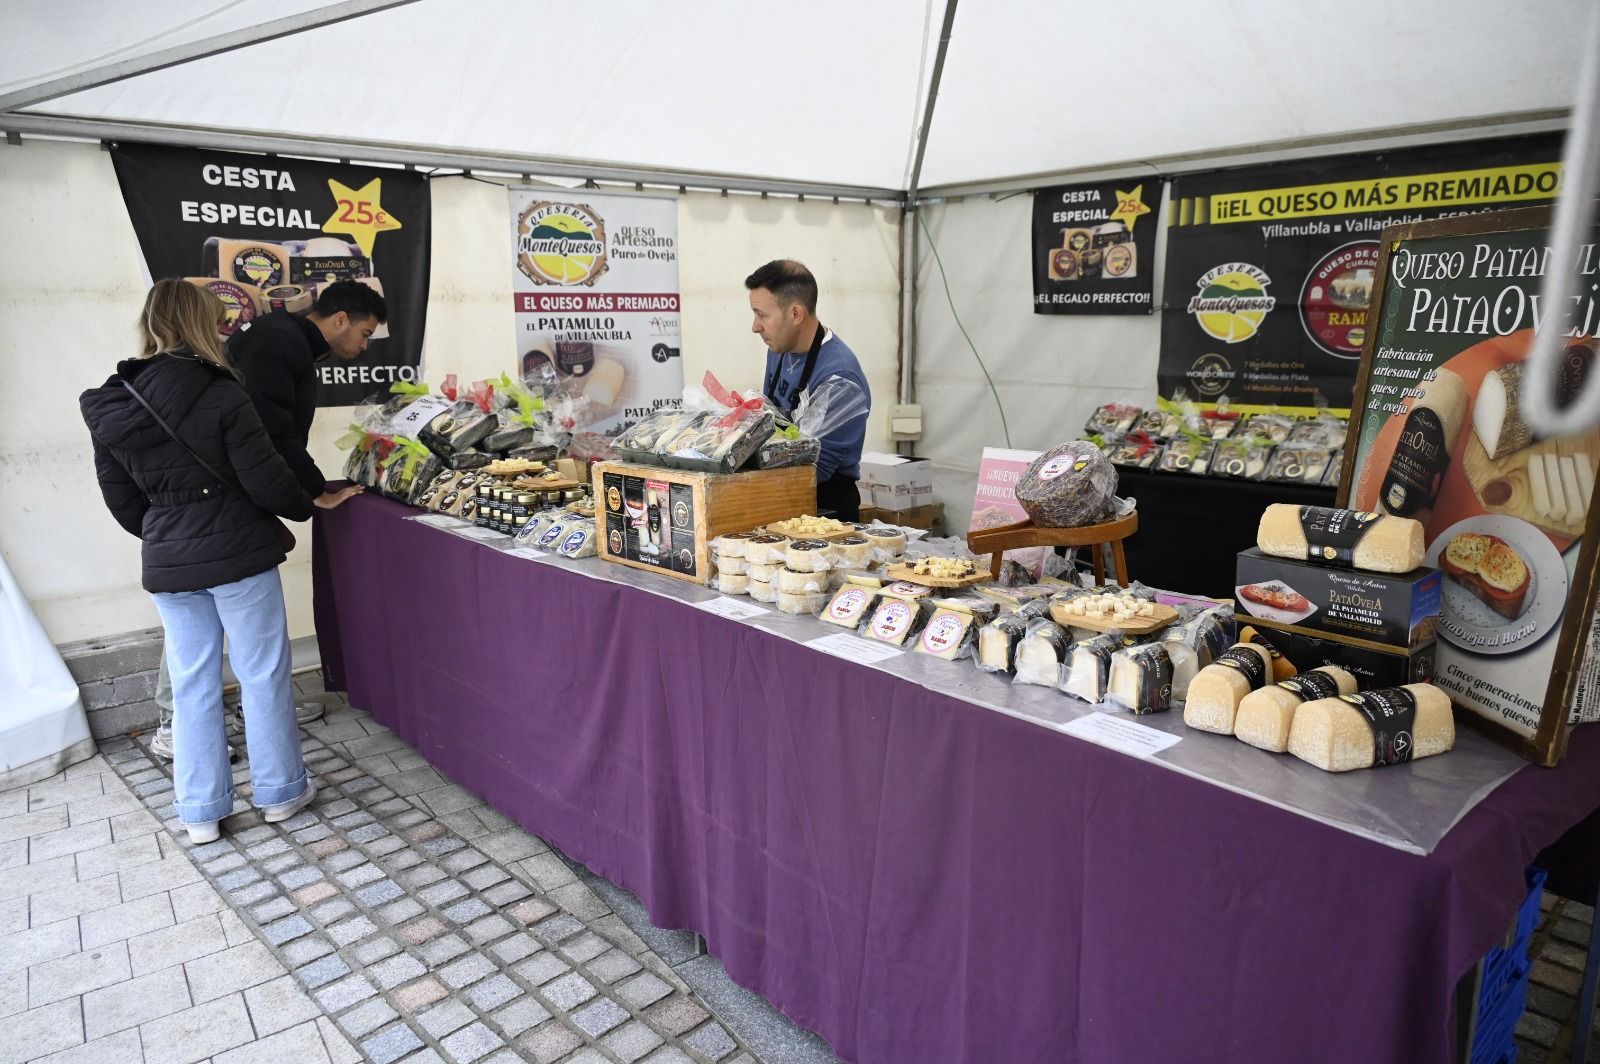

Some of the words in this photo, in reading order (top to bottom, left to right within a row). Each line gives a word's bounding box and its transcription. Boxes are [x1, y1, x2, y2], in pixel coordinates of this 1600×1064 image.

[202, 163, 297, 192] CESTA
[1062, 190, 1101, 204] CESTA
[1258, 191, 1338, 216] QUESO
[1344, 182, 1399, 208] MÁS
[181, 200, 321, 230] ESPECIAL
[338, 199, 387, 225] 25€
[1052, 208, 1110, 223] ESPECIAL
[621, 226, 655, 238] QUESO
[1262, 220, 1331, 239] Villanubla
[520, 238, 602, 257] MonteQuesos
[612, 232, 674, 248] Artesano
[611, 249, 637, 260] Puro
[638, 251, 646, 259] de
[647, 249, 676, 262] Oveja
[1318, 252, 1353, 279] QUESO
[1355, 249, 1370, 259] DE
[1391, 248, 1465, 289] QUESO
[524, 296, 537, 310] EL
[540, 296, 582, 311] QUESO
[587, 293, 614, 311] MÁS
[617, 296, 678, 311] PREMIADO
[1052, 293, 1091, 304] REGALO
[1092, 292, 1151, 304] PERFECTO!!
[1190, 297, 1274, 314] MonteQuesos
[526, 323, 537, 331] EL
[538, 317, 615, 330] PATAMULO
[1327, 312, 1368, 326] RAM
[566, 329, 632, 341] VILLANUBLA
[1376, 346, 1434, 363] Fabricación
[1374, 365, 1419, 381] artesanal
[1423, 368, 1438, 382] de
[1370, 383, 1399, 398] queso
[1401, 385, 1425, 400] puro
[1368, 399, 1381, 411] de
[1382, 402, 1408, 416] oveja
[1327, 573, 1352, 584] Queso
[1362, 579, 1387, 590] Autor
[1332, 603, 1341, 611] EL
[1341, 605, 1379, 618] PATAMULO
[1339, 612, 1383, 626] VALLADOLID
[1487, 635, 1500, 647] al
[1502, 620, 1538, 646] Horno
[1447, 663, 1474, 684] Cinco
[1473, 678, 1543, 716] generaciones
[1465, 688, 1501, 712] buenos
[1502, 706, 1539, 730] quesos
